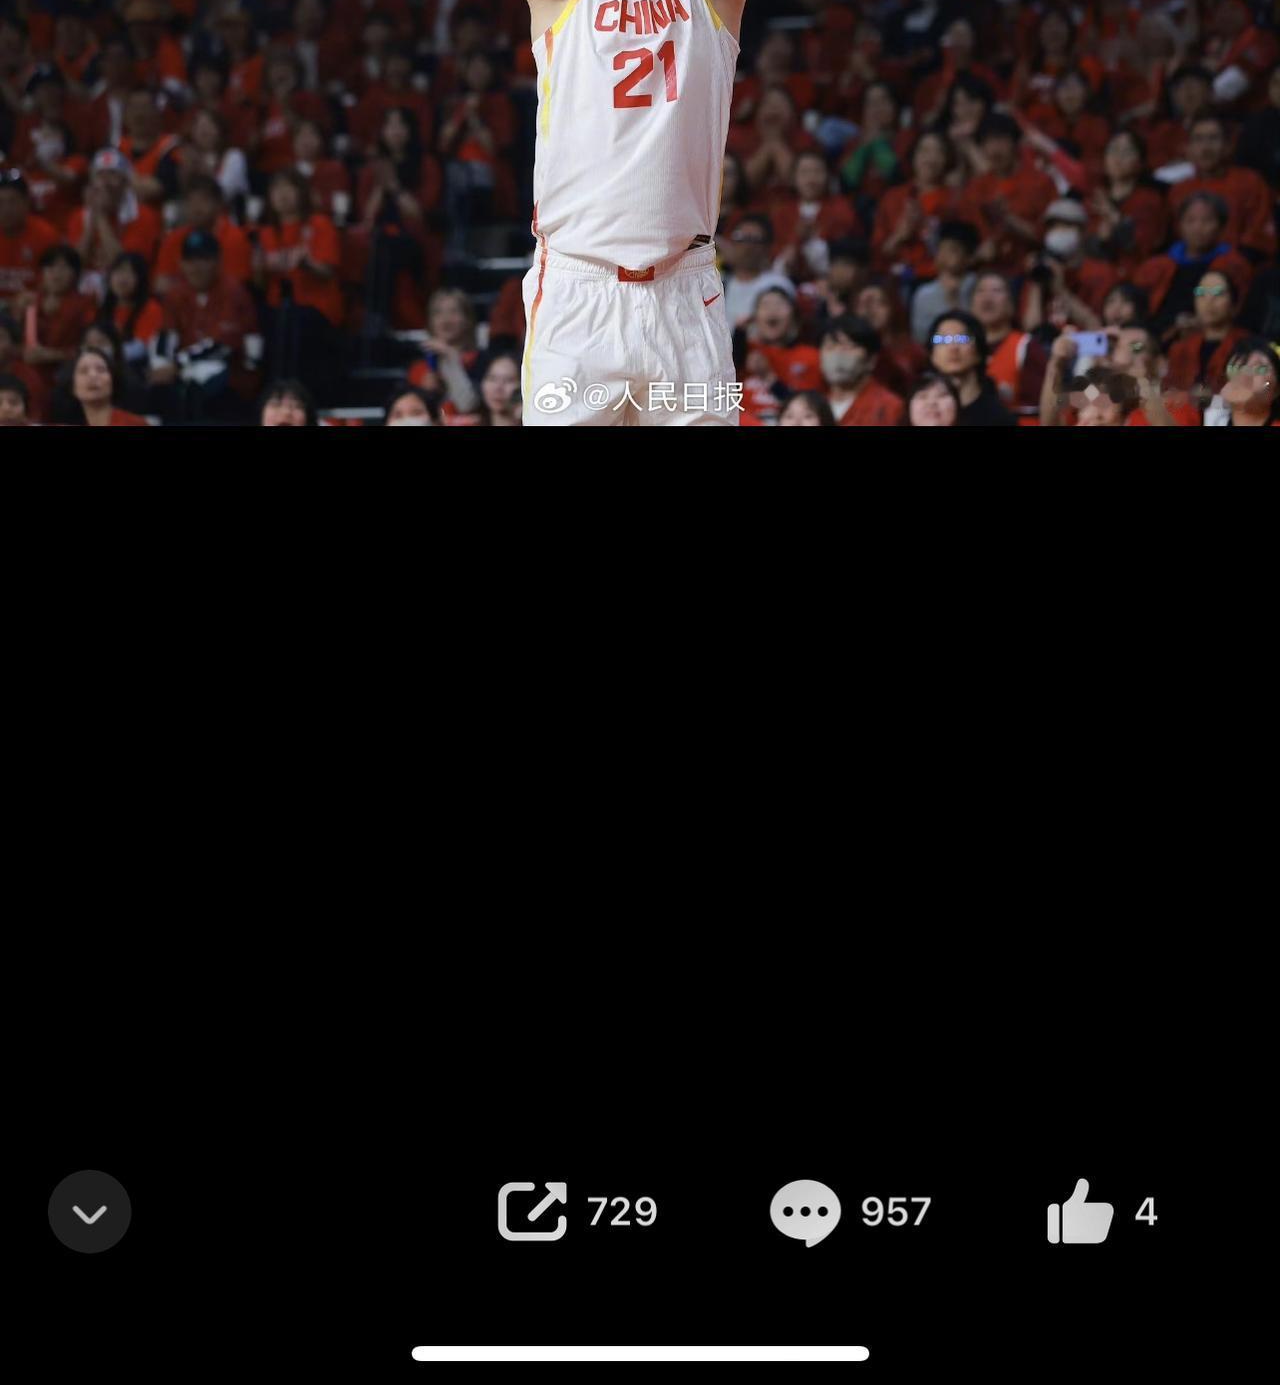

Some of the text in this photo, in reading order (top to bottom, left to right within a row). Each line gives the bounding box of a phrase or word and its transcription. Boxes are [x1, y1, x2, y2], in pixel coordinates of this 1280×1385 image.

[612, 39, 679, 109] 21
[587, 1197, 658, 1226] 729
[861, 1197, 932, 1226] 957
[1135, 1197, 1158, 1225] 4
